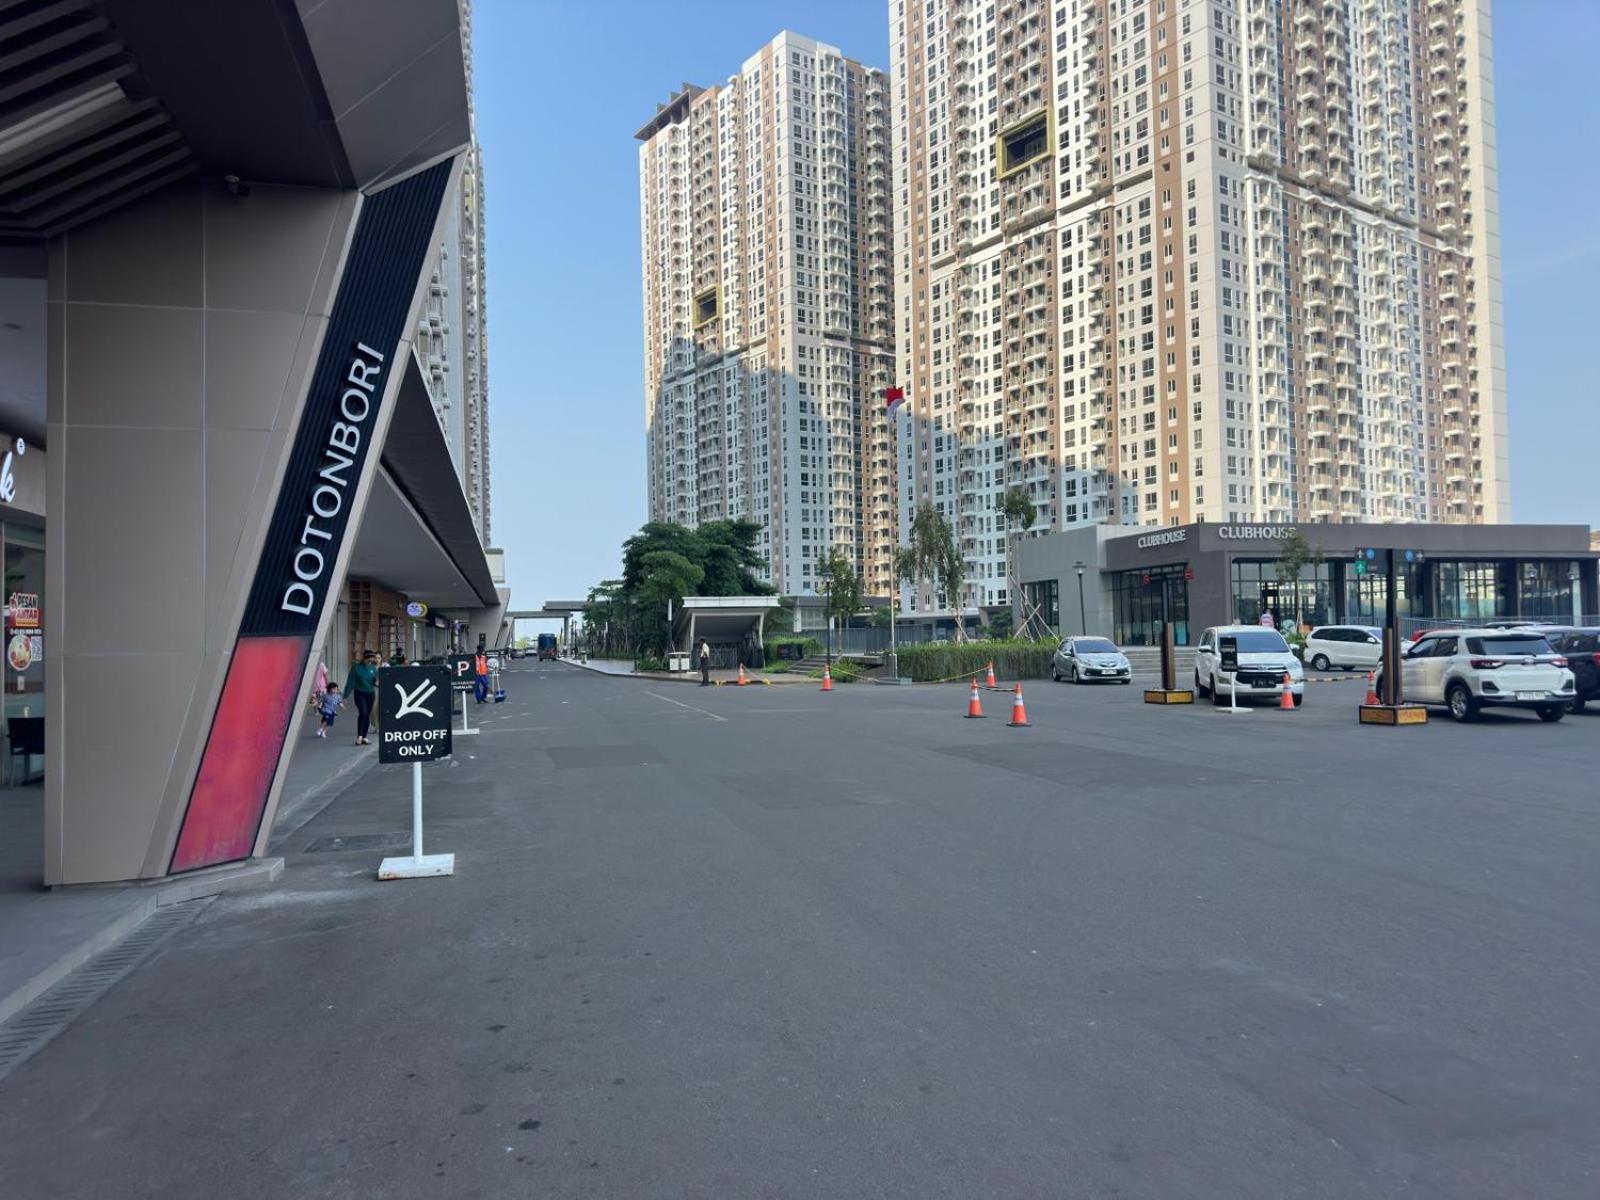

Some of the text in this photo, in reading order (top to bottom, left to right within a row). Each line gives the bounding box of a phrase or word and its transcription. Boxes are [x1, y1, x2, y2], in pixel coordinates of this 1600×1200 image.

[281, 342, 384, 615] DOTONBORI
[1138, 530, 1186, 548] CLUBHOUSE
[16, 594, 38, 609] PESAN
[457, 661, 470, 677] P
[384, 729, 448, 742] DROP OFF
[399, 745, 434, 757] ONLY
